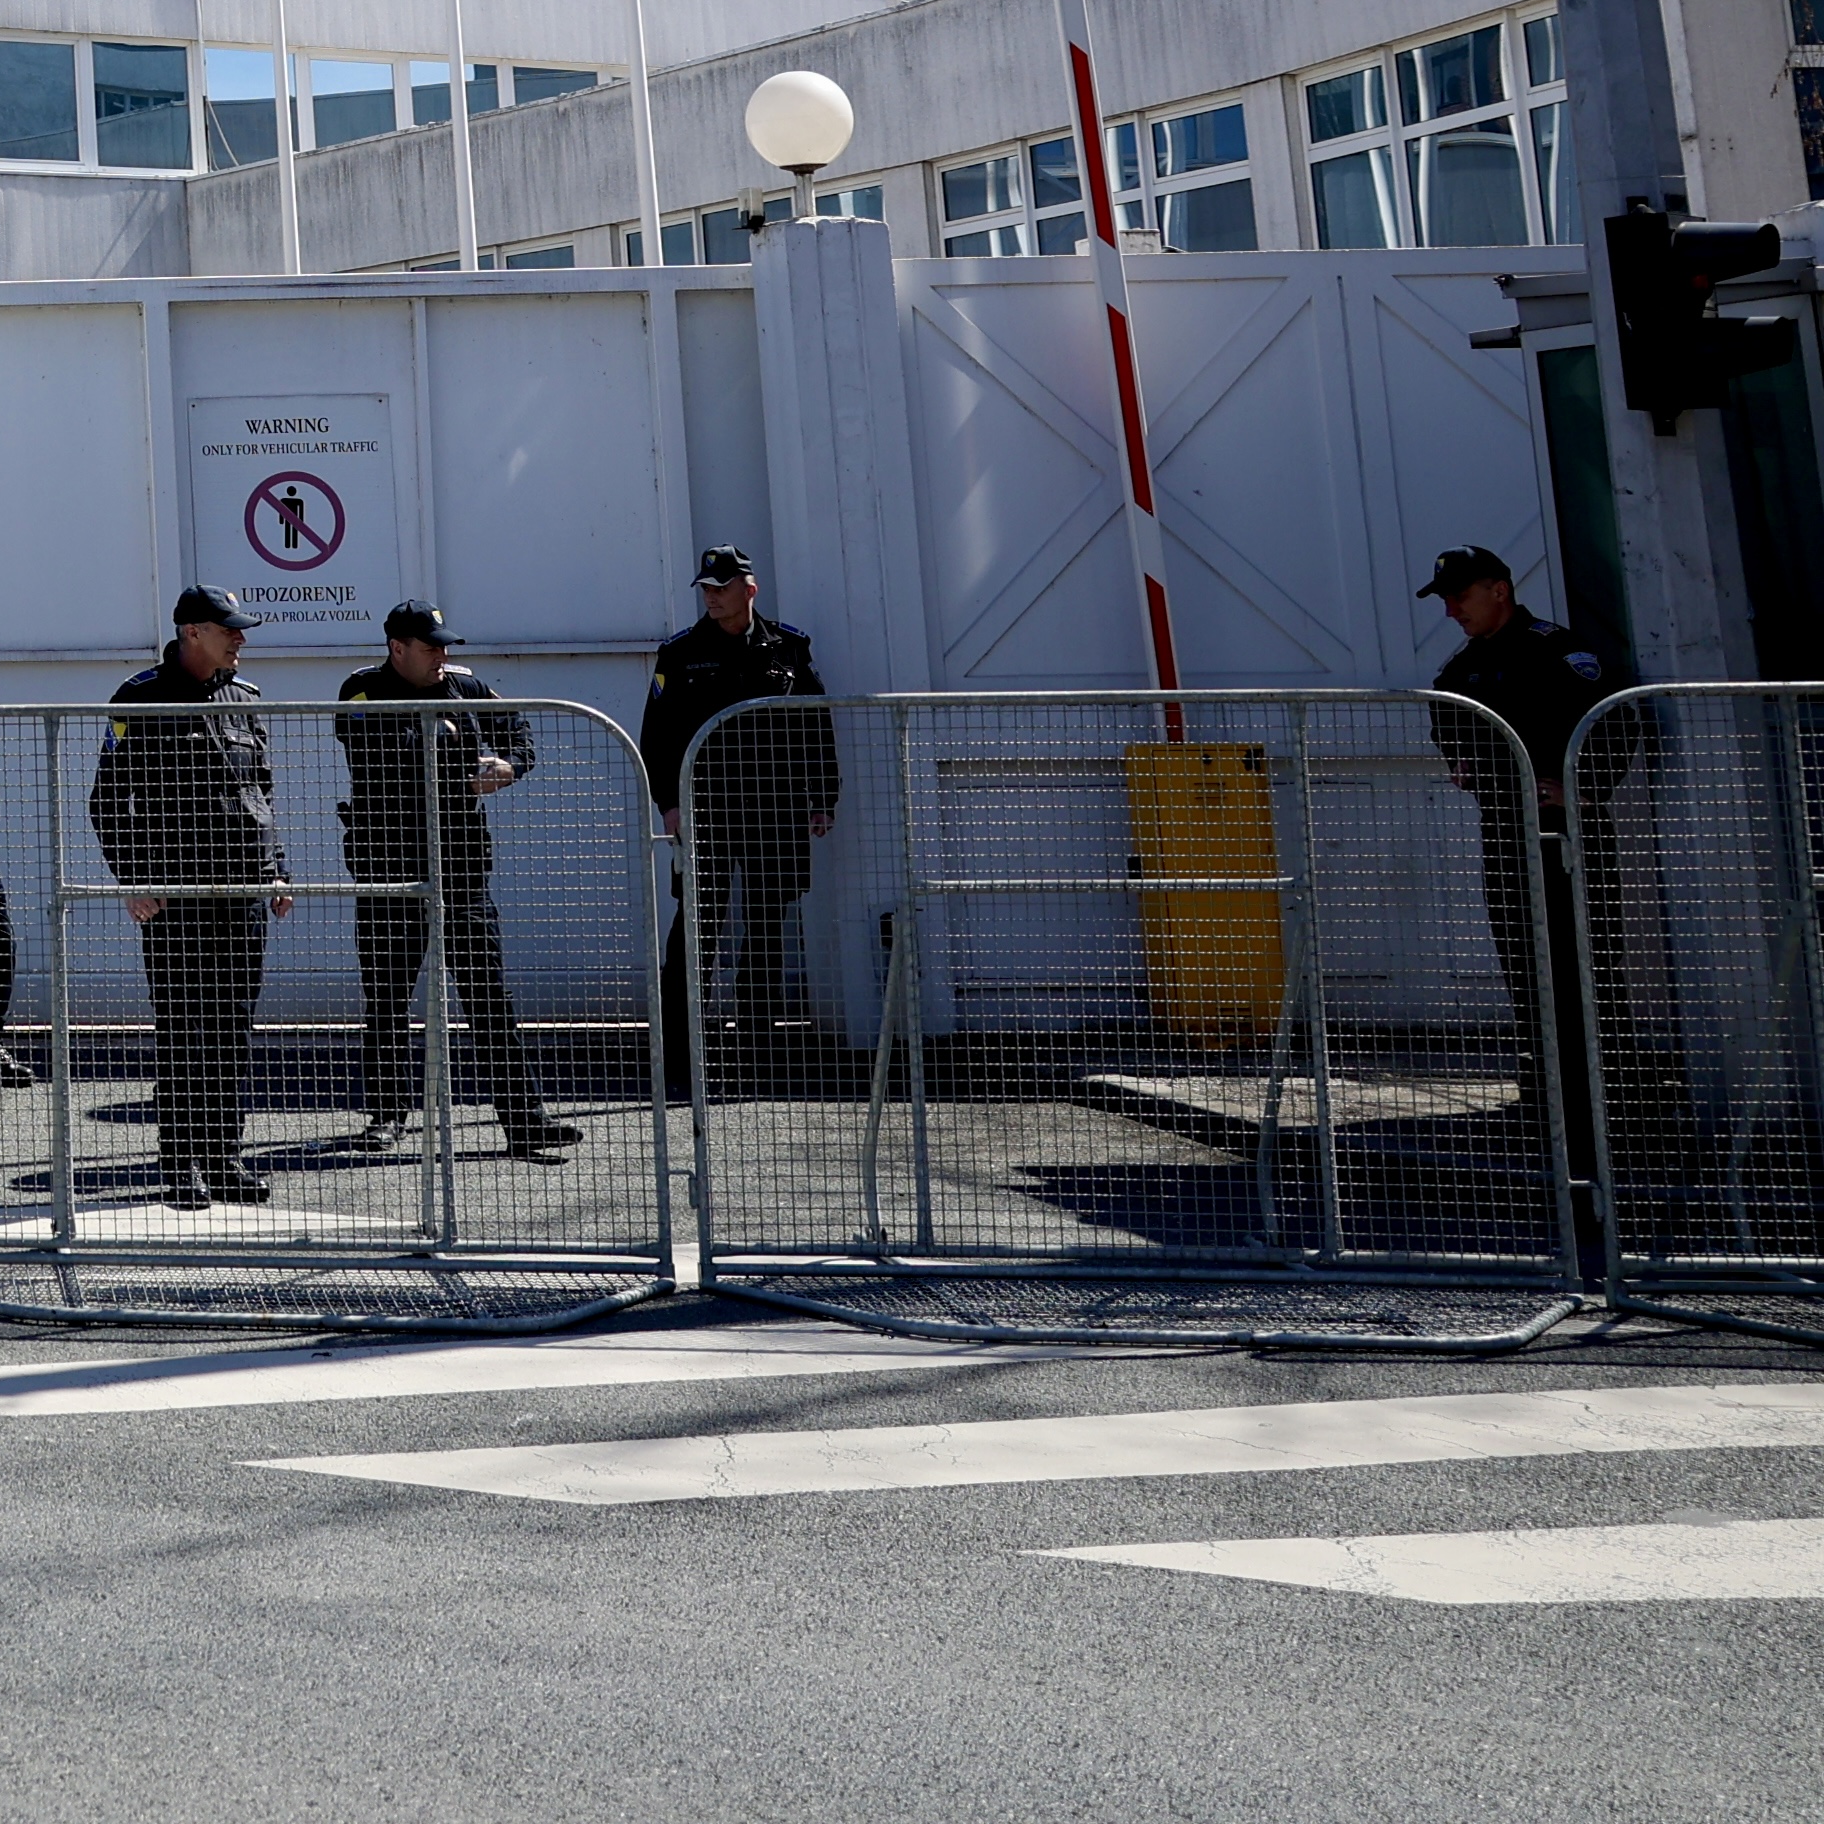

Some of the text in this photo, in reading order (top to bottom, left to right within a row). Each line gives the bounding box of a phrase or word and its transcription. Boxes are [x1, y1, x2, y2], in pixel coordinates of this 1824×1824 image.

[244, 417, 330, 434] WARNING
[202, 441, 379, 456] ONLY FOR VEHICULAR TRAFFIC
[241, 586, 356, 606] UPOZORENJE
[264, 611, 279, 623] ZA
[282, 610, 328, 622] PROLAZ
[329, 609, 371, 622] VOZILA
